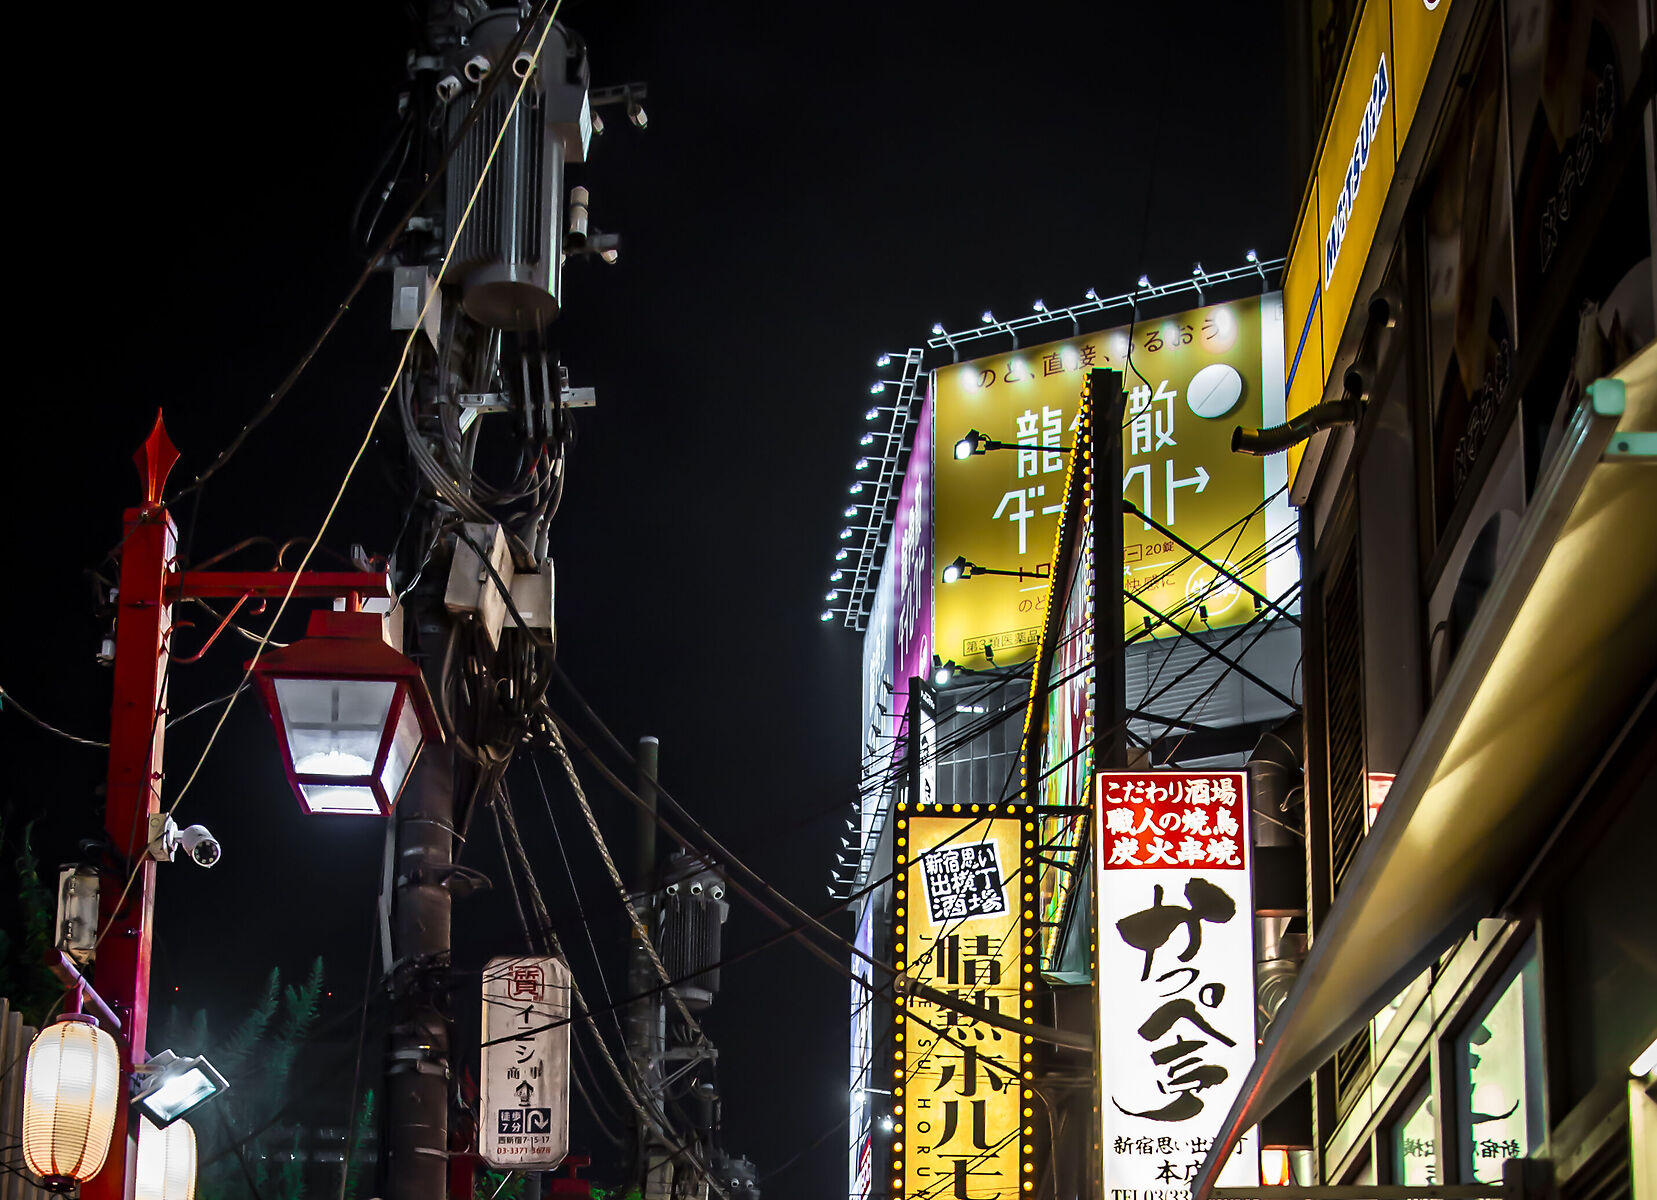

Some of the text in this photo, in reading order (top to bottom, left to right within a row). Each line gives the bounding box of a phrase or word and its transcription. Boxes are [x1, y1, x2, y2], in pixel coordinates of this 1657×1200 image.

[1016, 379, 1177, 478] 龍散
[992, 459, 1210, 554] ダクト
[1105, 778, 1237, 805] こだわり酒場
[1105, 805, 1239, 836] 職人の焼鳥
[924, 847, 995, 876] 新宿思い
[1107, 836, 1242, 868] 炭火串焼
[930, 866, 998, 897] 出横丁
[933, 890, 1003, 919] 酒場
[513, 969, 539, 996] 質
[502, 1122, 521, 1132] 7分
[1113, 1135, 1248, 1155] 新宿思い出丁
